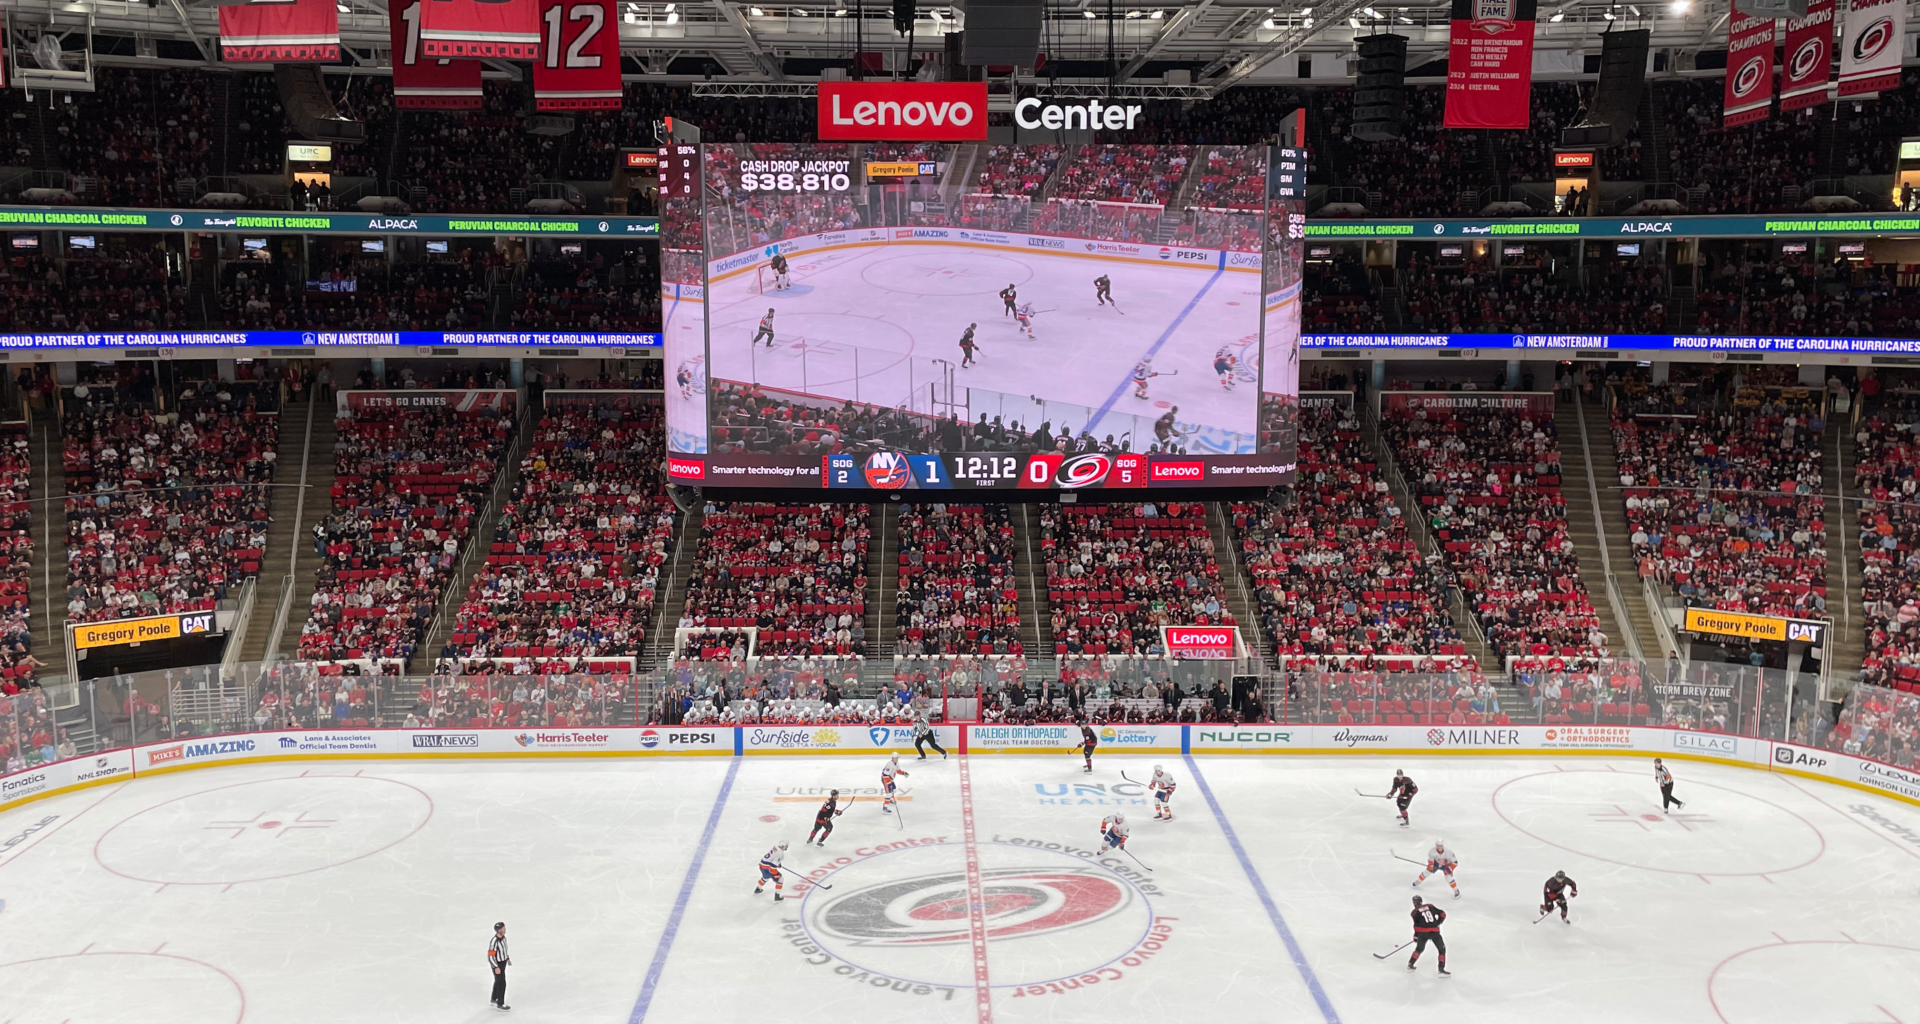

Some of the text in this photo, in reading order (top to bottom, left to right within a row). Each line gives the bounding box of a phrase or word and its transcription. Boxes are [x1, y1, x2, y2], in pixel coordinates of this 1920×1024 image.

[1481, 6, 1507, 17] FAME
[1788, 7, 1832, 32] CHAMPIONS
[545, 4, 604, 68] 12
[1452, 38, 1468, 46] 2022
[1729, 28, 1772, 53] CHAMPIONS
[1450, 71, 1466, 79] 2023
[1449, 82, 1465, 90] 2024
[831, 93, 974, 127] Lenovo
[1014, 97, 1142, 131] Center
[1281, 148, 1297, 158] FO%
[683, 159, 691, 168] 0
[1558, 156, 1590, 164] Lenovo
[740, 161, 850, 173] CASH DROP JACKPOT
[872, 166, 896, 174] Gregory
[919, 164, 935, 174] CAT
[1280, 162, 1296, 171] PIM
[683, 172, 691, 180] 4
[1280, 175, 1293, 183] SM
[740, 173, 851, 193] $38,810
[684, 185, 692, 194] 0
[1279, 187, 1294, 196] GVA
[44, 213, 147, 225] CHARCOAL CHICKEN
[236, 216, 330, 228] FAVORITE CHICKEN
[368, 219, 418, 229] ALPACA
[448, 220, 579, 232] PERUVIAN CHARCOAL CHICKEN
[1331, 224, 1414, 235] CHARCOAL CHICKEN
[1491, 223, 1580, 235] FAVORITE CHICKEN
[1620, 222, 1673, 233] ALPACA
[1765, 219, 1920, 232] PERUVIAN CHARCOAL CHICKEN
[823, 233, 846, 241] Fanatics
[913, 230, 949, 238] AMAZING
[1097, 243, 1118, 252] Harris
[1118, 244, 1140, 253] Teeter
[1177, 251, 1208, 261] PEPSI
[716, 252, 760, 273] ticketmaster
[0, 335, 33, 347] ROUD
[35, 335, 87, 346] PARTNER
[87, 335, 101, 346] OF
[102, 334, 125, 345] THE
[126, 334, 180, 345] CAROLINA
[317, 333, 338, 345] NEW
[338, 333, 393, 345] AMSTERDAM
[443, 333, 475, 344] PROUD
[476, 333, 518, 344] PARTNER
[519, 334, 531, 344] OF
[532, 334, 551, 344] THE
[551, 334, 596, 344] CAROLINA
[1315, 336, 1326, 346] OF
[1327, 336, 1346, 346] THE
[1346, 336, 1390, 346] CAROLINA
[1526, 336, 1547, 348] NEW
[1547, 336, 1601, 348] AMSTERDAM
[1673, 337, 1920, 352] PROUD PARTNER OF THE CAROLINA HURRICANES
[161, 348, 174, 356] 130
[612, 347, 624, 355] 102
[1462, 349, 1474, 357] 107
[1712, 351, 1725, 359] 108
[363, 396, 447, 407] LET'S GO CANES
[1423, 397, 1528, 409] CAROLINA CULTURE
[669, 461, 701, 475] Lenovo
[832, 459, 853, 468] SOG
[954, 457, 1017, 478] 12:12
[1116, 459, 1137, 468] SOG
[1211, 465, 1245, 475] Smarter
[1245, 464, 1287, 475] technology
[712, 465, 820, 476] Smarter technology for all
[837, 470, 848, 483] 2
[926, 461, 940, 483] 1
[1029, 460, 1049, 483] 0
[1121, 470, 1132, 483] 5
[1155, 465, 1200, 477] Lenovo
[87, 615, 212, 642] Gregory Poole CAT
[1697, 616, 1820, 643] Gregory Poole CAT
[1172, 631, 1228, 645] Lenovo
[1653, 685, 1732, 698] STORM BREW ZONE
[331, 734, 372, 742] Associates
[536, 732, 609, 743] Harris Teeter
[750, 728, 810, 745] Surfside
[974, 727, 1068, 739] RALEIGH ORTHOPAEDIC
[1200, 732, 1291, 743] NUCOR
[1332, 728, 1389, 748] Wegmans
[1448, 729, 1520, 745] MILNER
[1587, 728, 1631, 736] SURGERY
[413, 735, 476, 747] WRAL NEWS
[669, 733, 716, 744] PEPSI
[1117, 734, 1157, 745] Lottery
[1566, 735, 1630, 744] ORTHODONTICS
[1678, 735, 1732, 750] SILAC
[152, 739, 256, 761] MIKE'S AMAZING
[350, 742, 377, 750] Dentist
[2, 772, 46, 792] Fanatics
[1858, 776, 1898, 792] JOHNSON
[2, 783, 47, 801] Sportsbook
[1035, 783, 1145, 797] UNC
[1038, 798, 1149, 806] HEALTH
[782, 834, 948, 899] Lenovo Center
[992, 834, 1164, 897] Lenovo Center
[1421, 910, 1435, 923] 19
[780, 917, 955, 1001] Center Lenovo
[1012, 916, 1180, 998] Lenovo Center
